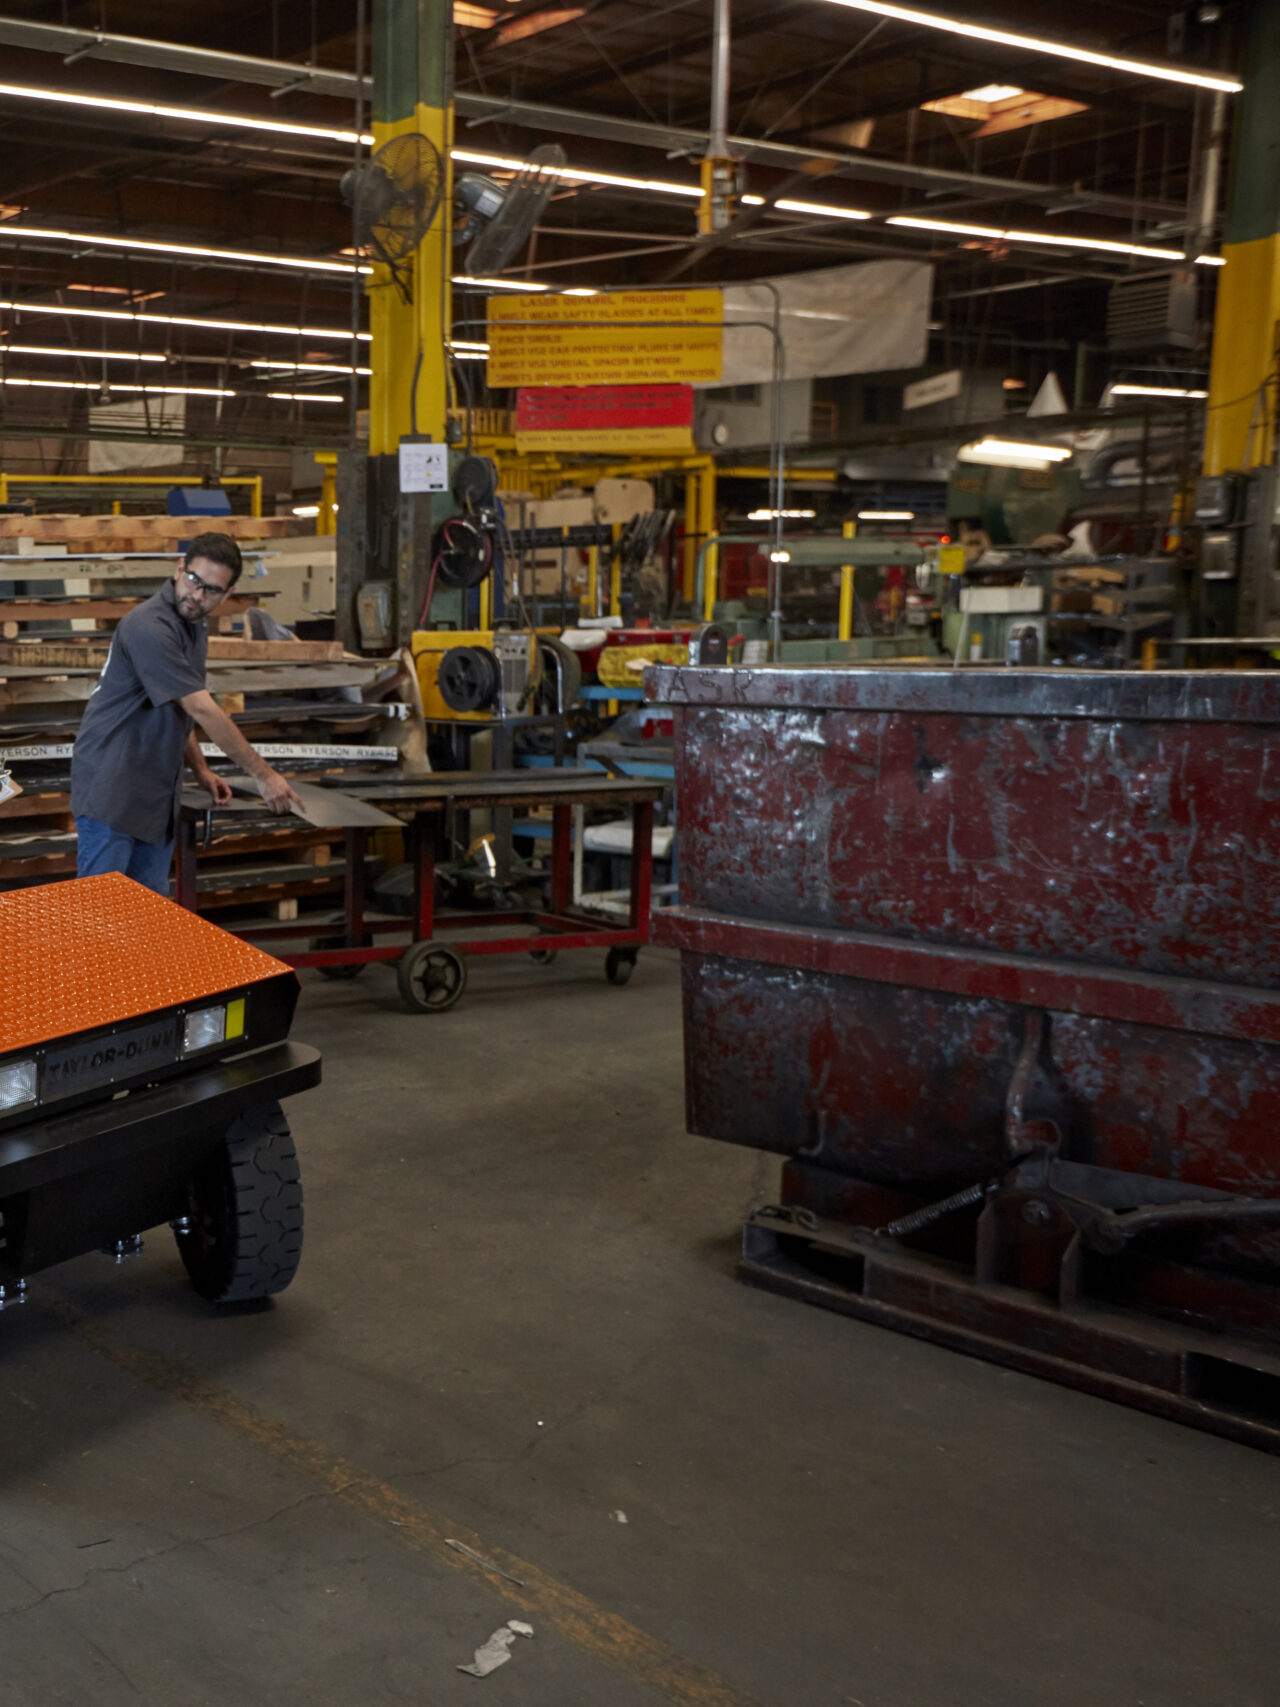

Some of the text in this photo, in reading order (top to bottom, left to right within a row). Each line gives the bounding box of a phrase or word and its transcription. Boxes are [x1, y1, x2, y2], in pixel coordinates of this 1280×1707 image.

[622, 293, 686, 305] PROCEDURE
[257, 746, 293, 754] ERSON
[301, 746, 349, 756] RYERSON
